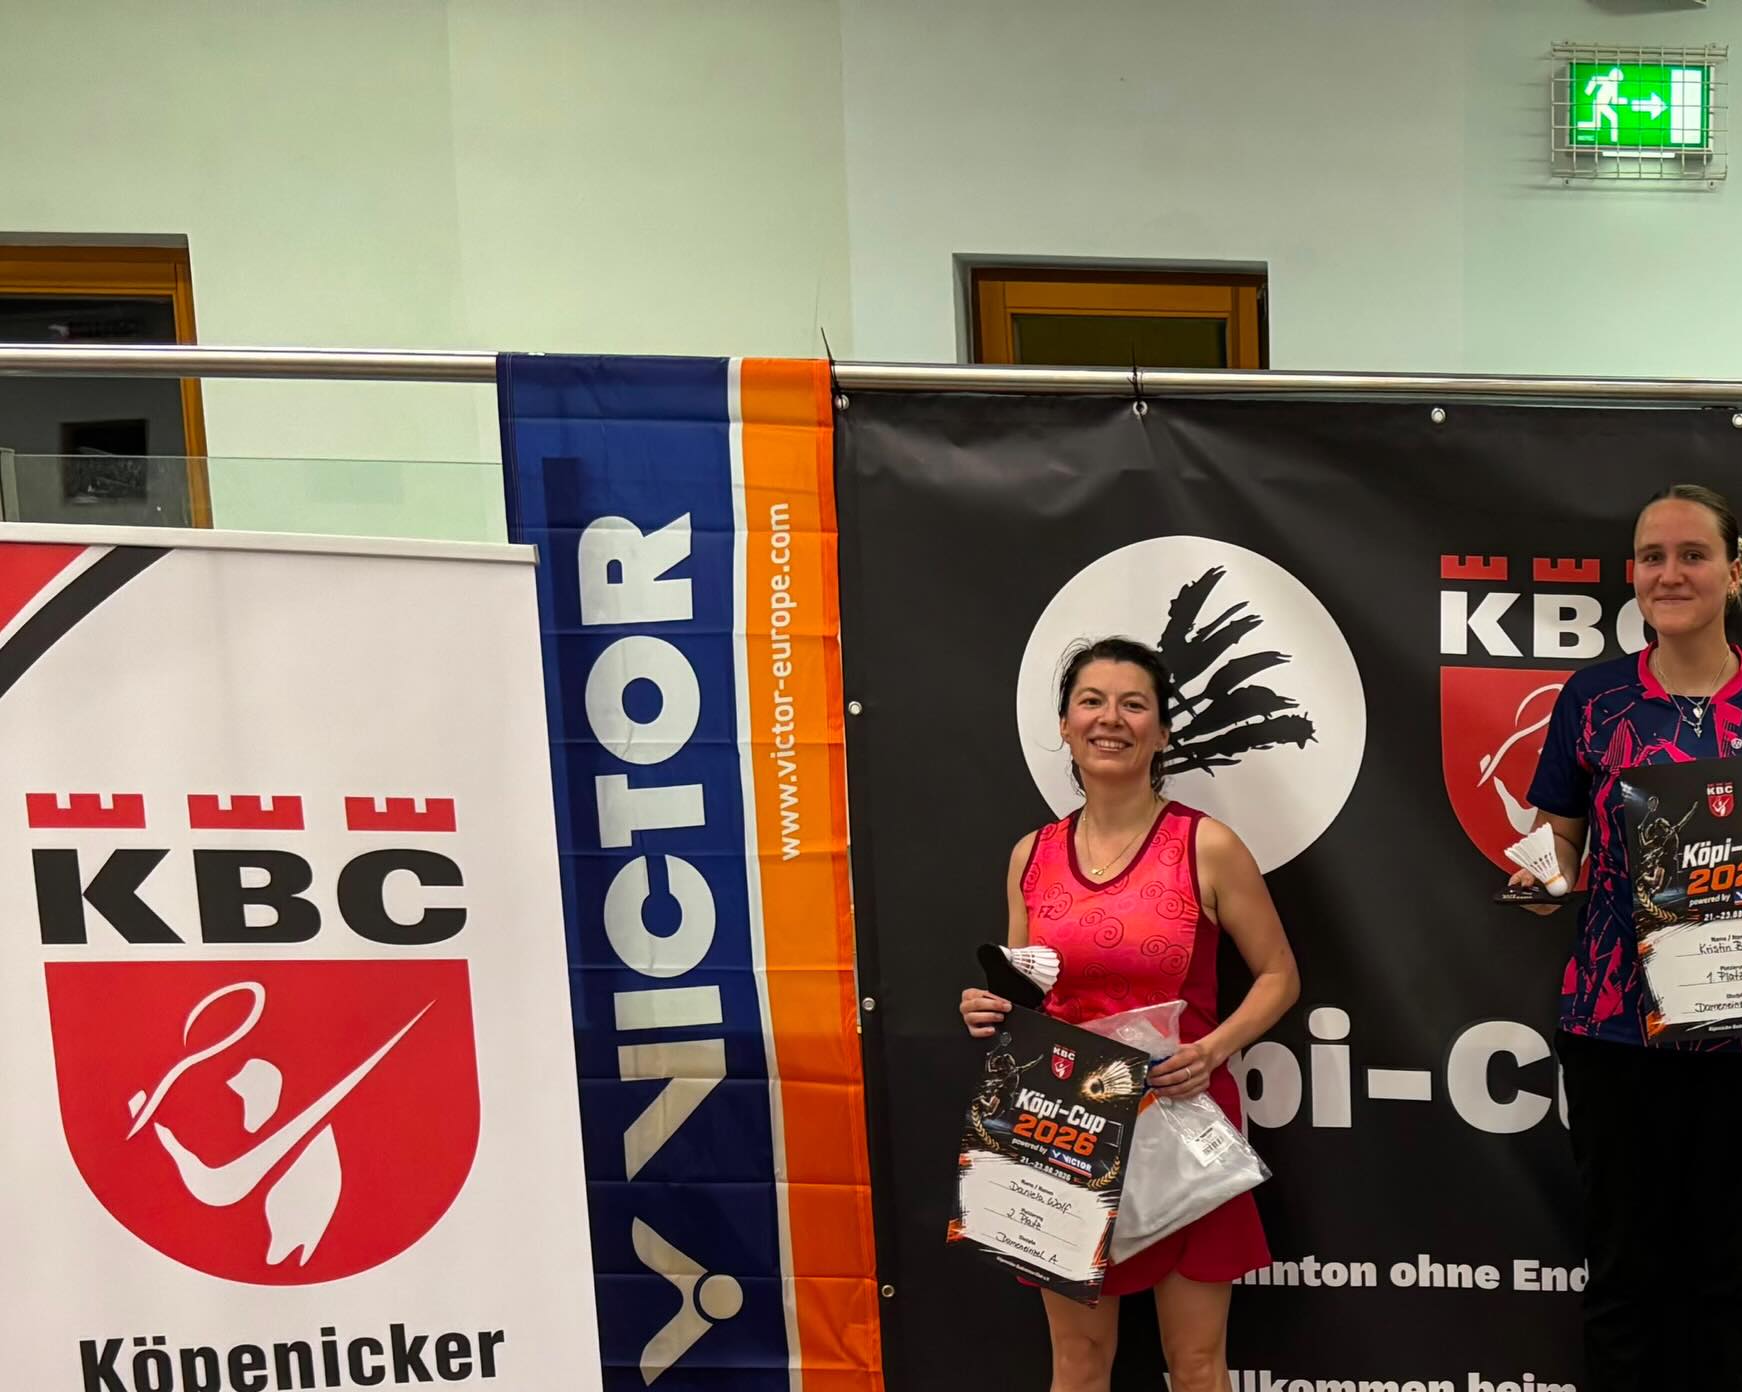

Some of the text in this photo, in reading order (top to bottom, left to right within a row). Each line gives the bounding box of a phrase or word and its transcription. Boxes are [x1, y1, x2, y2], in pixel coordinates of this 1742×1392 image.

[767, 502, 802, 862] www.victor-europe.com
[1706, 785, 1733, 796] KBC
[577, 511, 727, 1183] VICTOR
[32, 848, 468, 945] KBC
[1689, 895, 1721, 907] powered
[1721, 893, 1731, 902] by
[1706, 971, 1713, 983] 1
[1053, 1046, 1076, 1061] KBC
[1015, 1088, 1106, 1134] Köpi-Cup
[1013, 1113, 1098, 1156] 2026
[1012, 1138, 1092, 1172] powered by VICTOR
[1047, 1197, 1072, 1214] Wolf
[1048, 1254, 1059, 1265] A
[1232, 1253, 1590, 1292] inton ohne End
